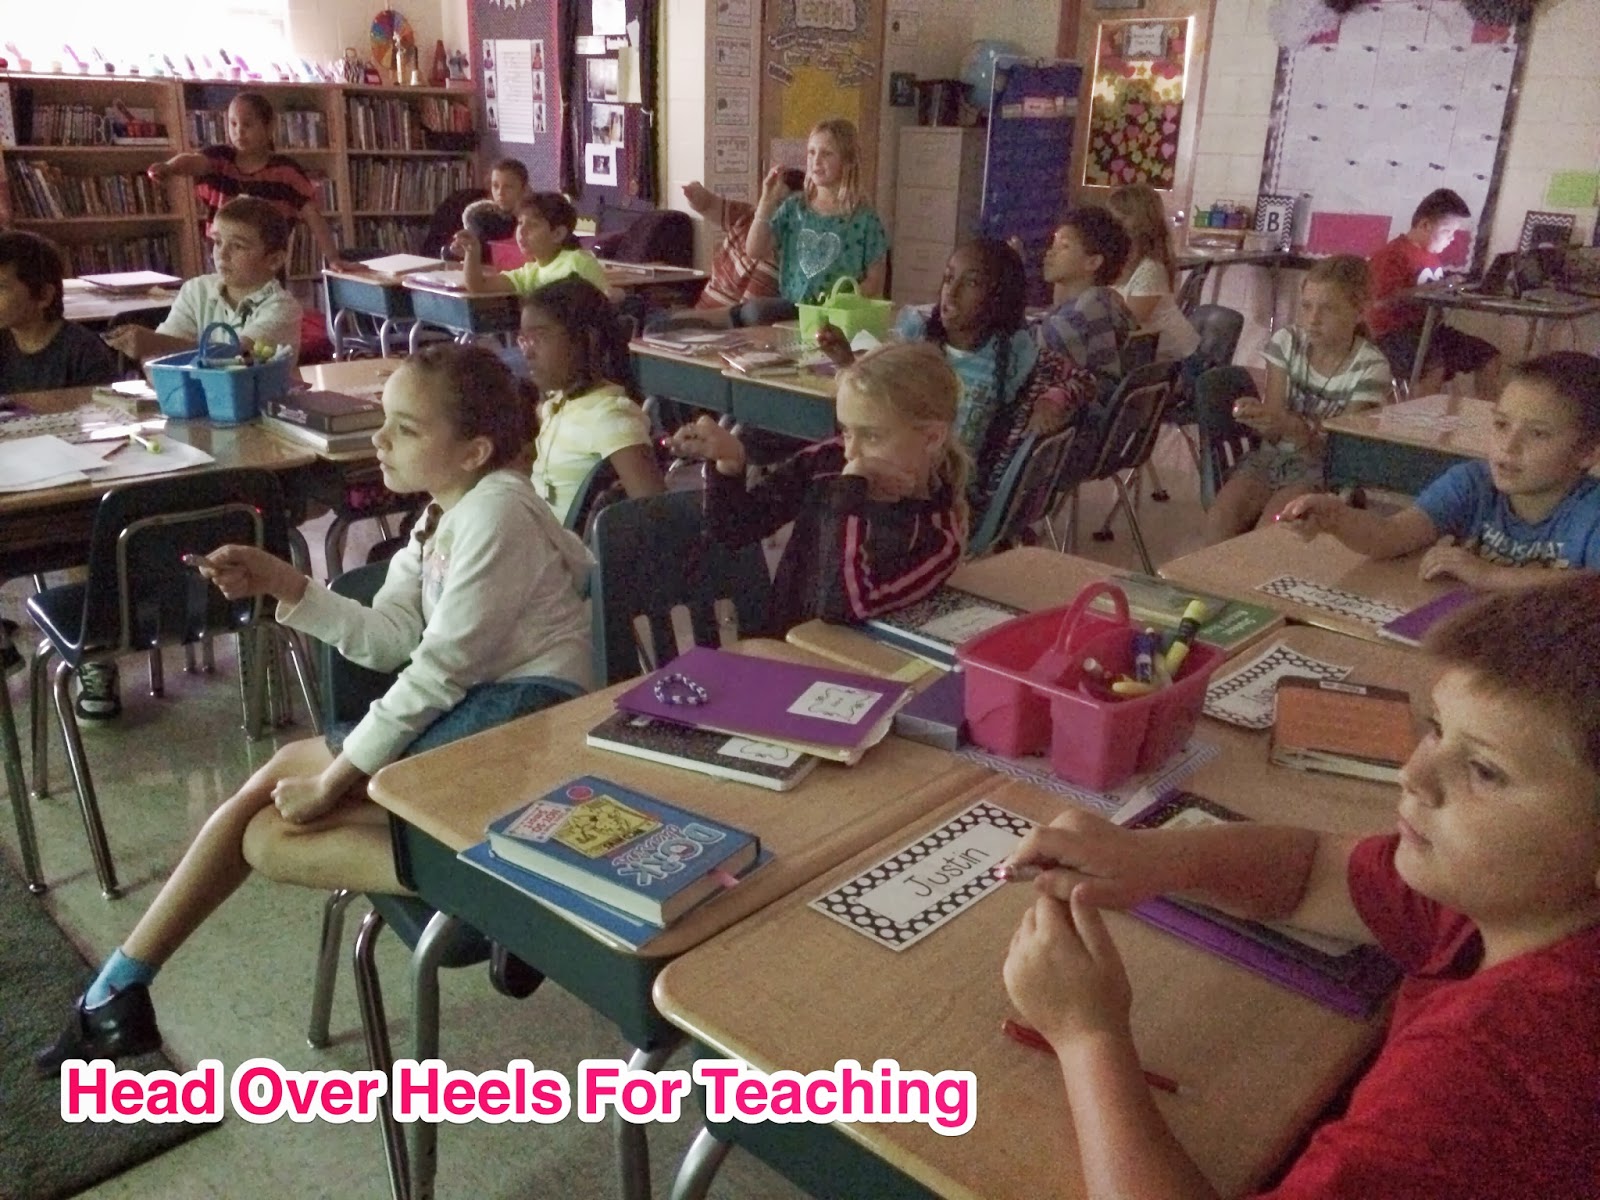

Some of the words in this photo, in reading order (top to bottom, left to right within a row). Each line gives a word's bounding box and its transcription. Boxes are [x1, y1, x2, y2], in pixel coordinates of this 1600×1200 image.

[1267, 212, 1280, 232] B
[616, 822, 727, 886] DORK
[901, 845, 989, 899] Justin
